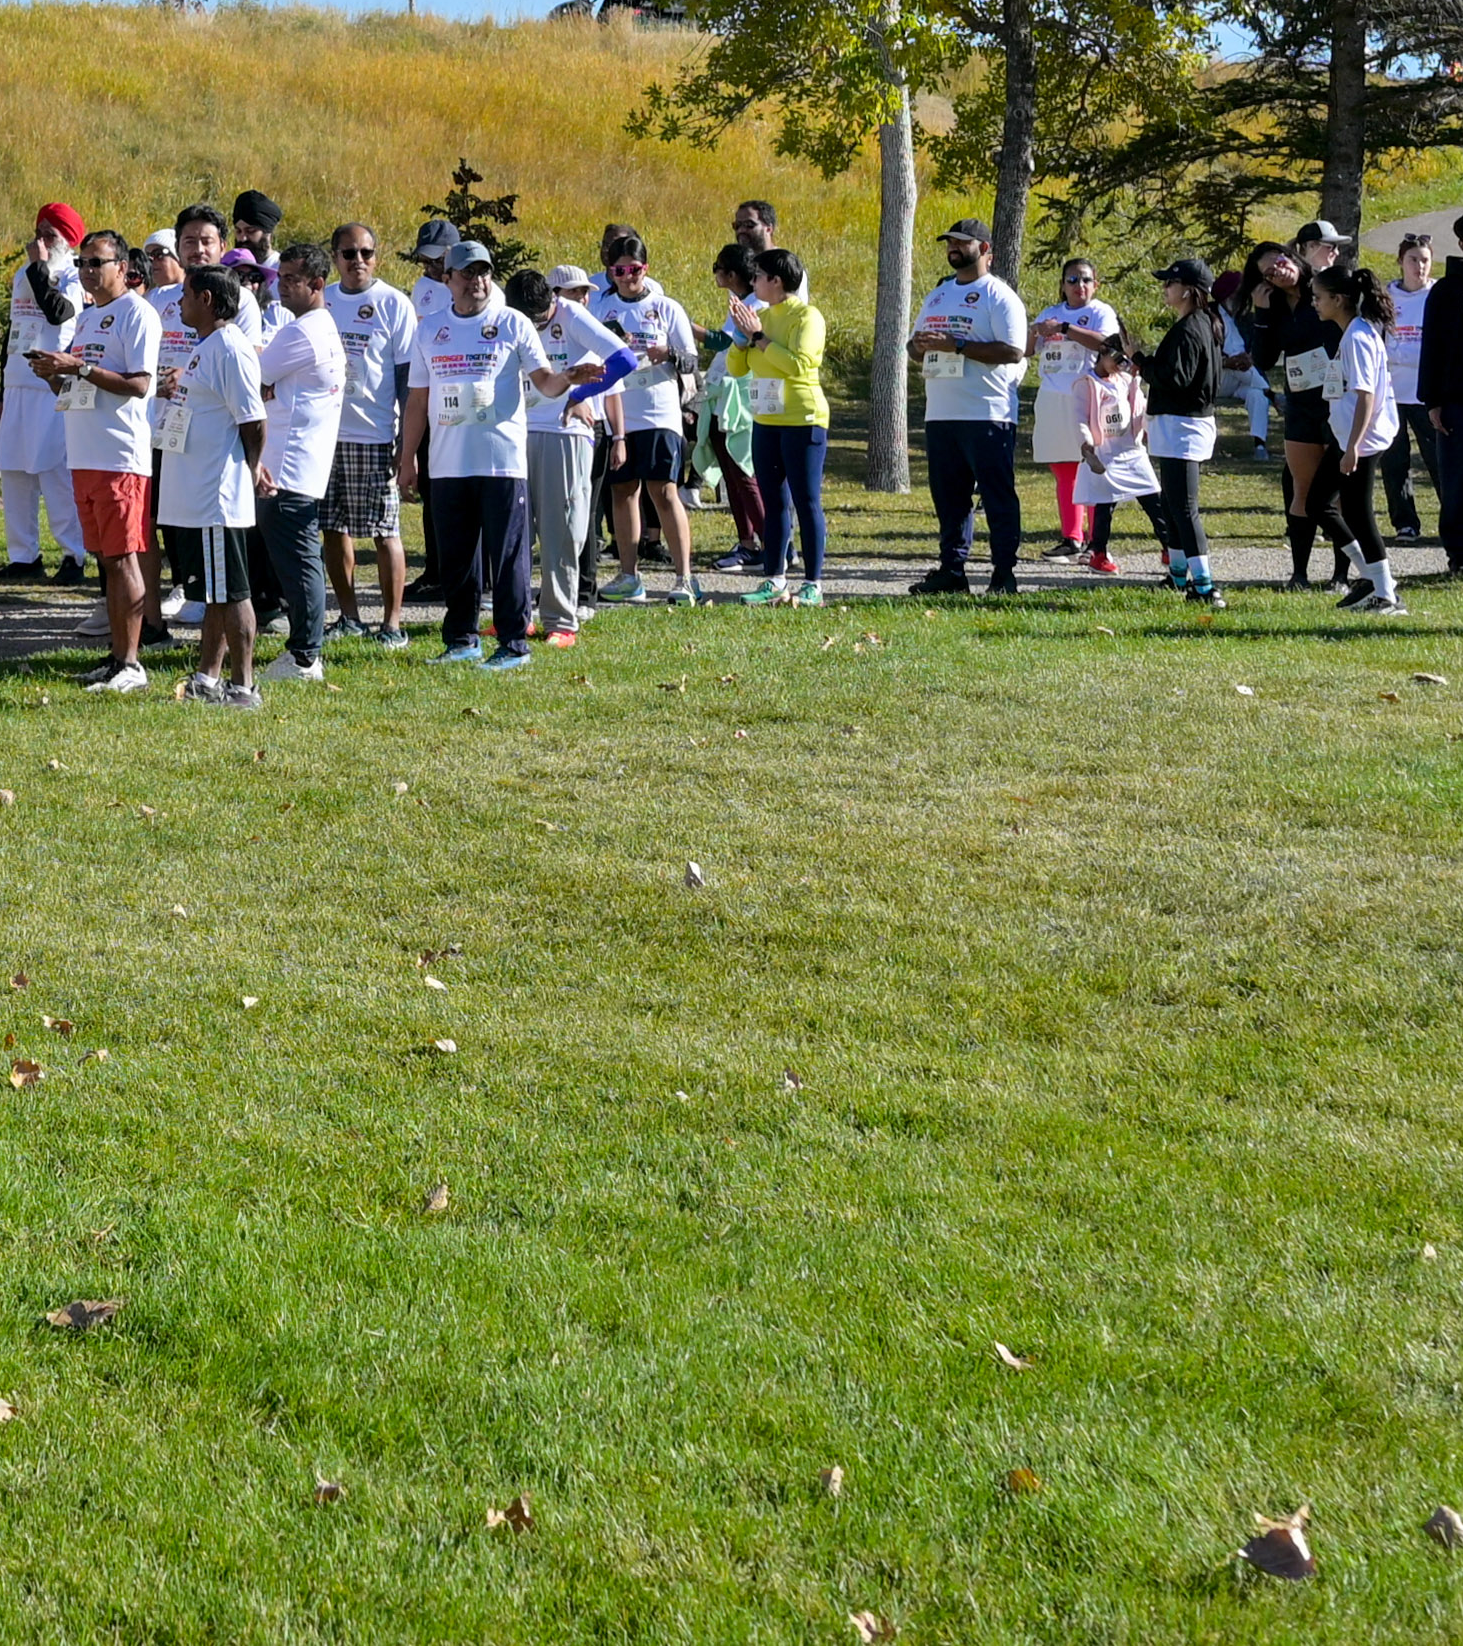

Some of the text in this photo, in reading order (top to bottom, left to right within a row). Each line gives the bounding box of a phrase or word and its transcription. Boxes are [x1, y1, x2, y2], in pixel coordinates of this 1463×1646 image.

[431, 354, 498, 363] STRONGER TOGETHER
[443, 396, 459, 408] 114
